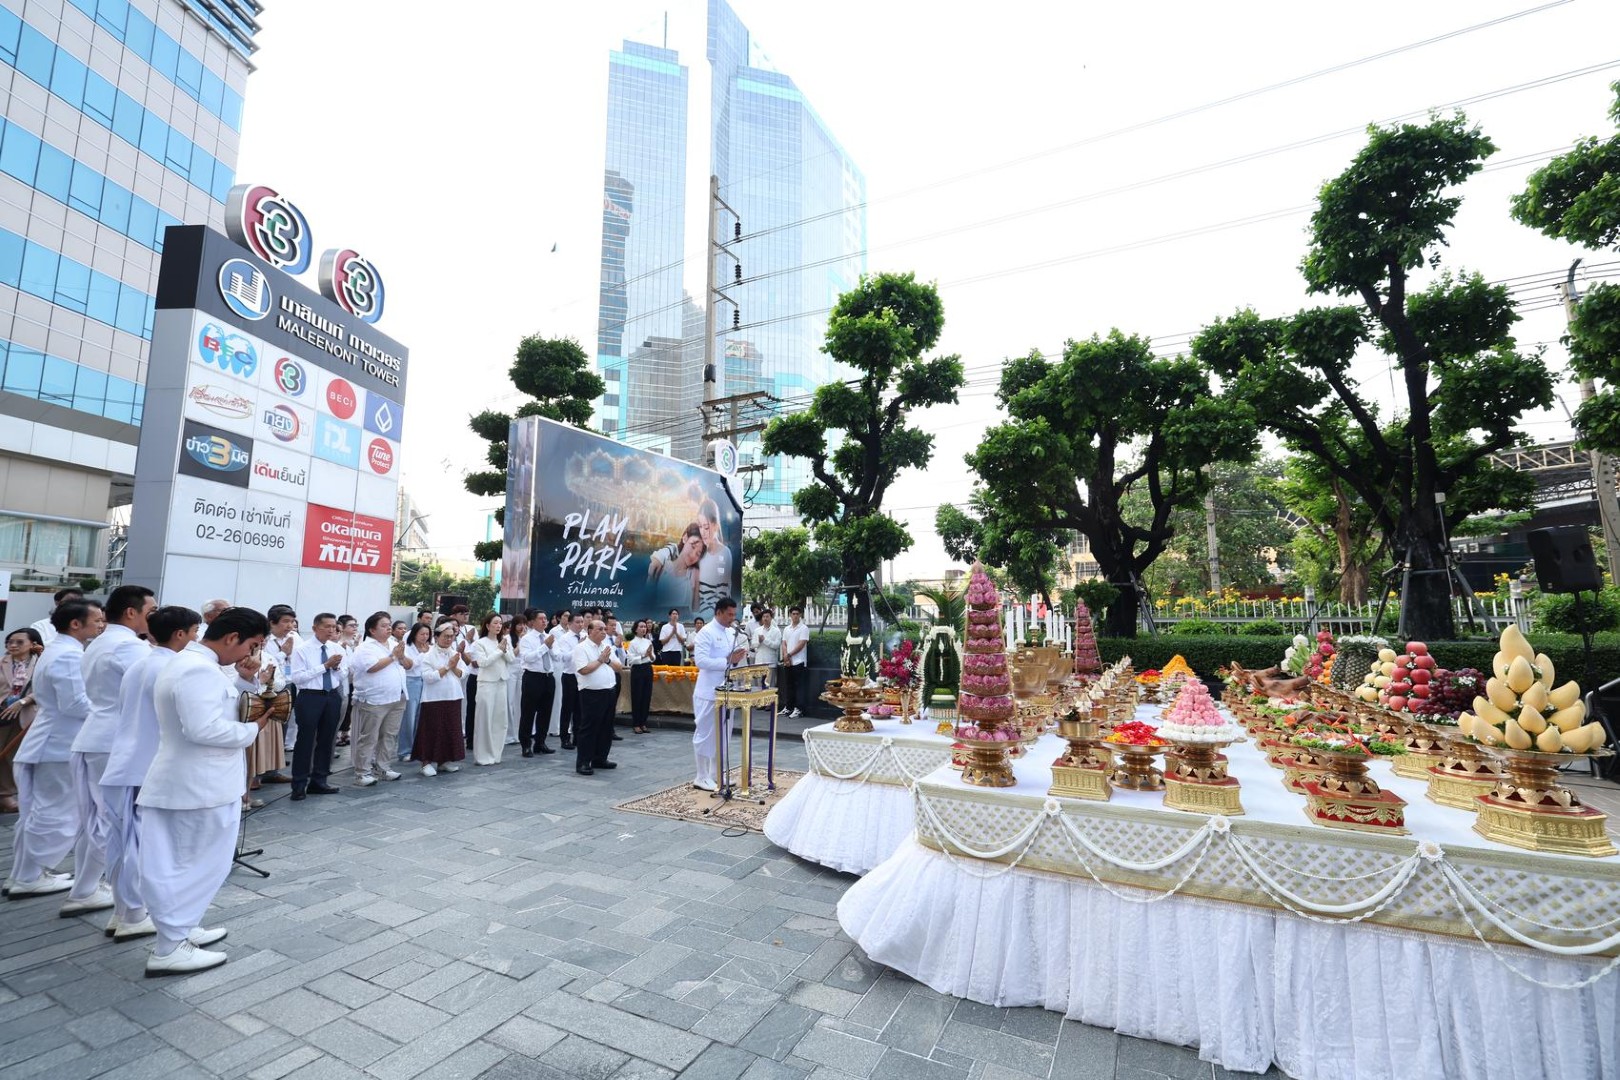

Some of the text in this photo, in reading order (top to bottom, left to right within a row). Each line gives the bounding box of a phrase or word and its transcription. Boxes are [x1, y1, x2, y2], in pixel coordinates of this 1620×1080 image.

[203, 335, 253, 365] BEC
[278, 315, 399, 388] MALEENONT TOWER
[349, 333, 402, 372] ทาวเวอร์
[208, 435, 232, 466] 3
[371, 444, 391, 461] Tune
[193, 497, 291, 529] ติดต่อ เช่าพื้นที่
[562, 508, 629, 547] PLAY
[195, 524, 286, 549] 02-2606996
[318, 543, 381, 567] オカムラ
[559, 541, 633, 580] PARK
